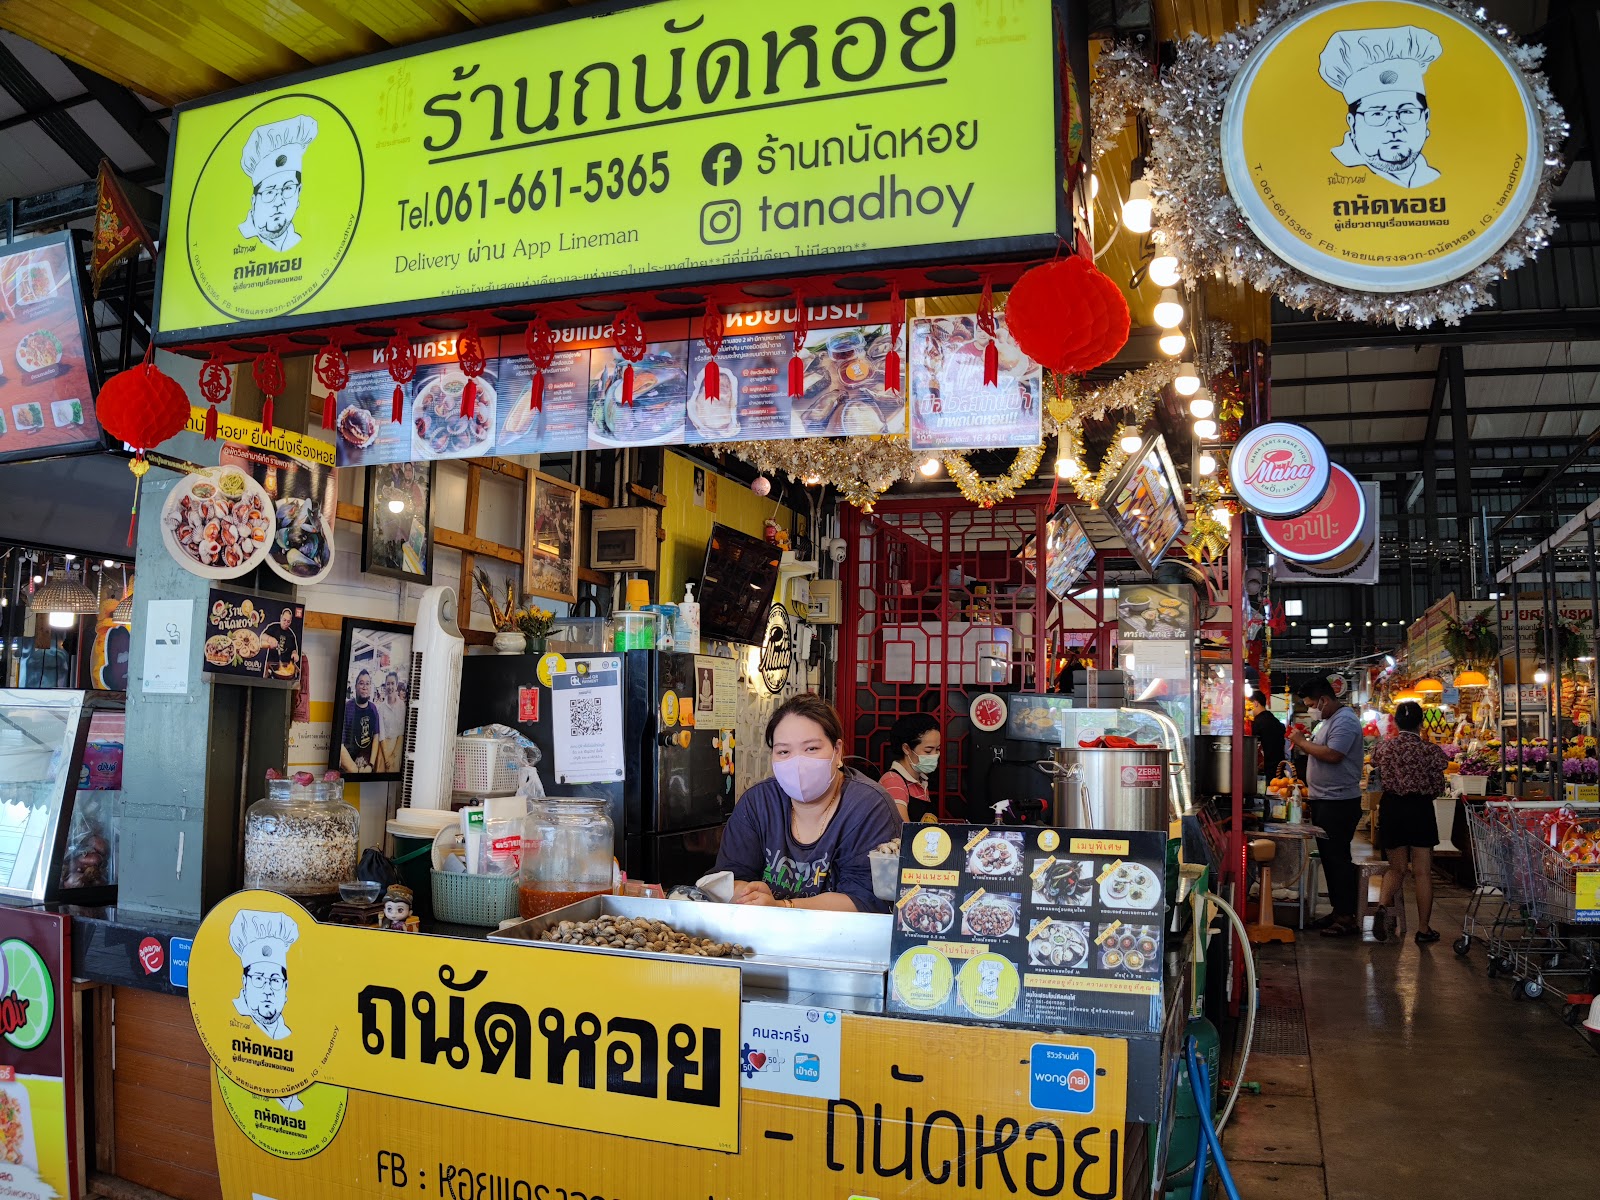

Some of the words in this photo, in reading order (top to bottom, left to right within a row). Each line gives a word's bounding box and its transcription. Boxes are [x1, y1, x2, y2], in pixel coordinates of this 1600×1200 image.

[423, 2, 957, 152] ร้านถนัดหอย
[757, 119, 979, 175] ร้านถนัดหอย
[397, 150, 670, 232] Tel.061-661-5365
[759, 175, 974, 228] tanadhoy
[1260, 179, 1313, 240] 061-6615365
[1342, 228, 1476, 262] หอยแครงลวก-ถนัดหอย
[1496, 153, 1523, 206] tanadhoy
[1333, 194, 1446, 217] ถนัดหอย
[333, 213, 355, 261] tanadhoy
[1334, 217, 1450, 232] ผู้เชี่ยวชาญเรื่องหอยหอย
[394, 250, 460, 275] Delivery
[468, 239, 505, 264] ผ่าน
[513, 238, 551, 259] App
[559, 228, 639, 252] Lineman
[233, 257, 303, 281] ถนัดหอย
[252, 427, 336, 465] ยืนหนึ่งเรื่องหอย
[1251, 446, 1261, 463] MANA
[1282, 439, 1298, 448] BAKE
[1244, 458, 1316, 485] Mana
[1282, 483, 1297, 492] TART
[1138, 768, 1161, 776] ZEBRA
[1077, 841, 1122, 853] เมนูพิเศษ
[903, 872, 956, 884] เมนูแนะนำ
[194, 1013, 222, 1064] 061-6615365
[321, 1025, 340, 1065] tanadhoy
[358, 964, 721, 1107] ถนัดหอย
[752, 1025, 809, 1043] คนละครึ่ง
[232, 1037, 293, 1062] ถนัดหอย
[768, 1056, 778, 1064] 50
[254, 1108, 306, 1131] ถนัดหอย
[826, 1064, 1118, 1199] ถนัดหอย
[378, 1150, 408, 1187] FB
